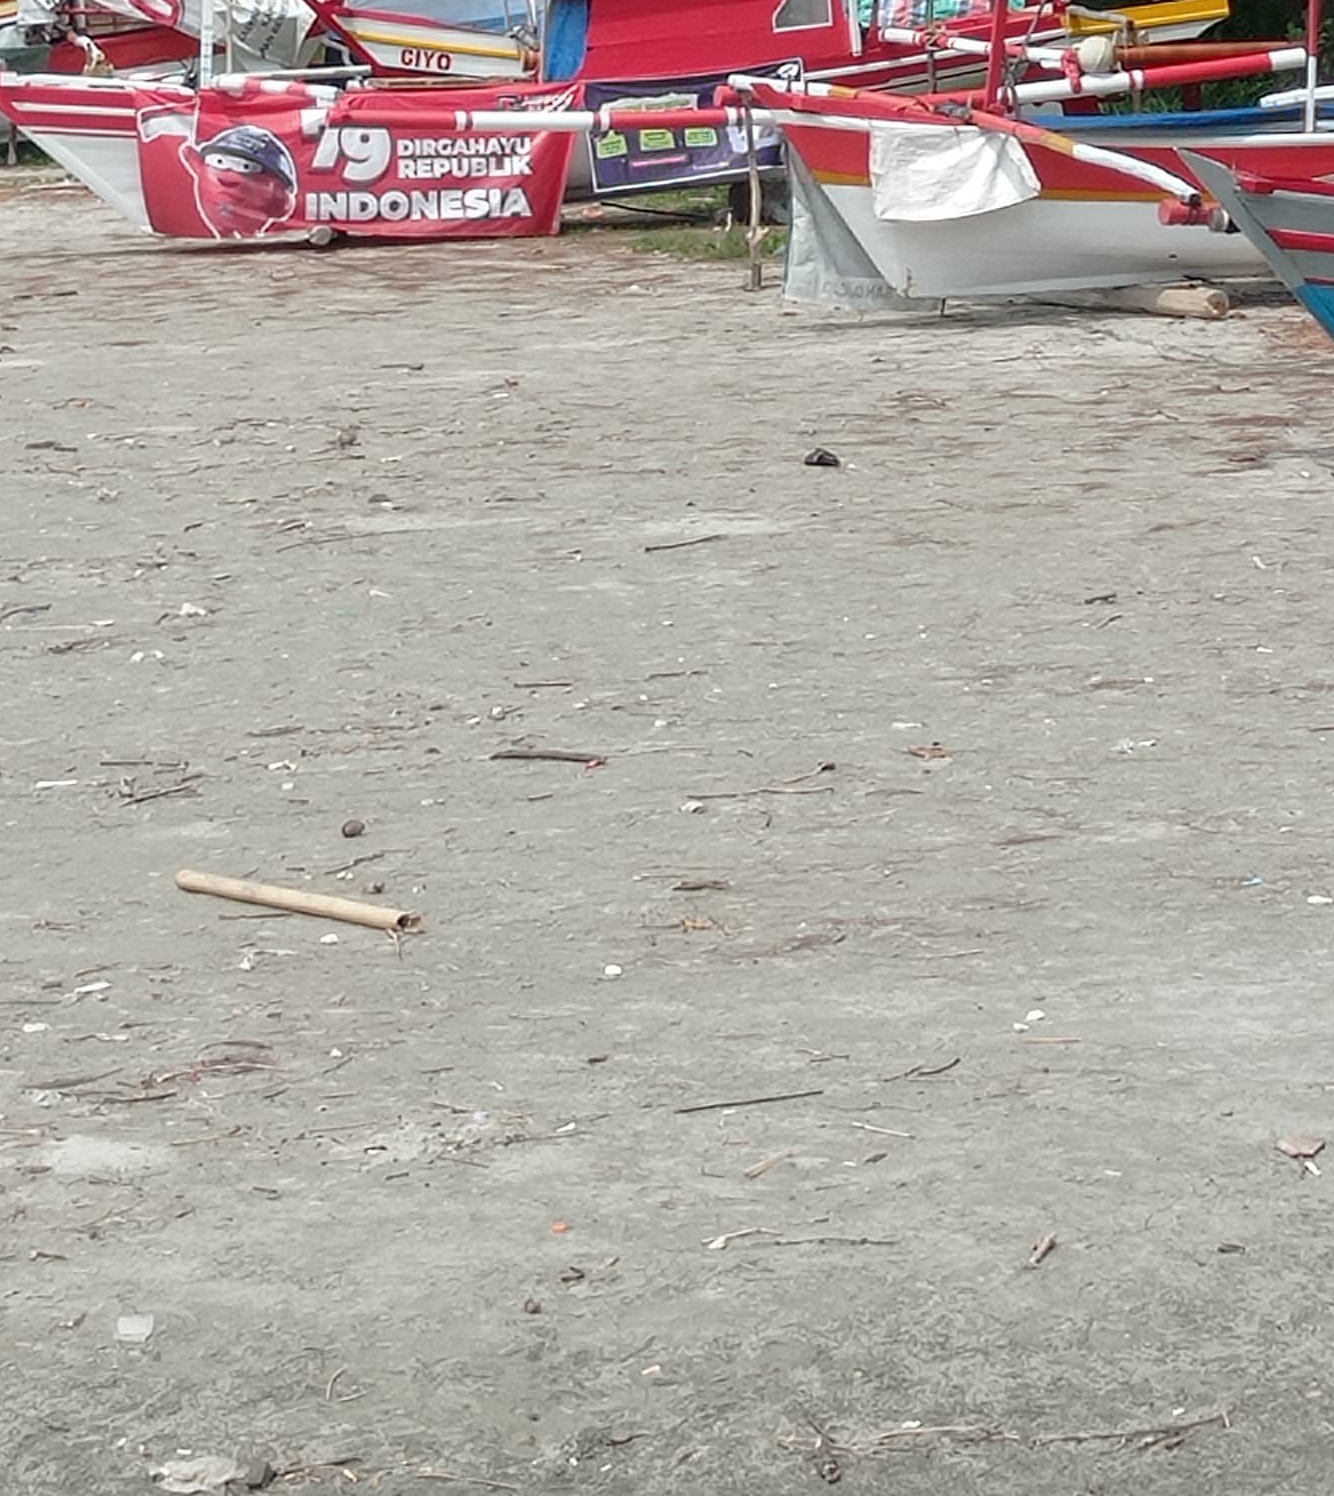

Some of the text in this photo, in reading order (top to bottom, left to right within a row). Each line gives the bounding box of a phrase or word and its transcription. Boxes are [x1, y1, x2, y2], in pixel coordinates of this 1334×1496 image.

[397, 137, 532, 157] DIRGAHAYU
[397, 155, 533, 180] REPUBLIK
[305, 187, 533, 222] INDONESIA
